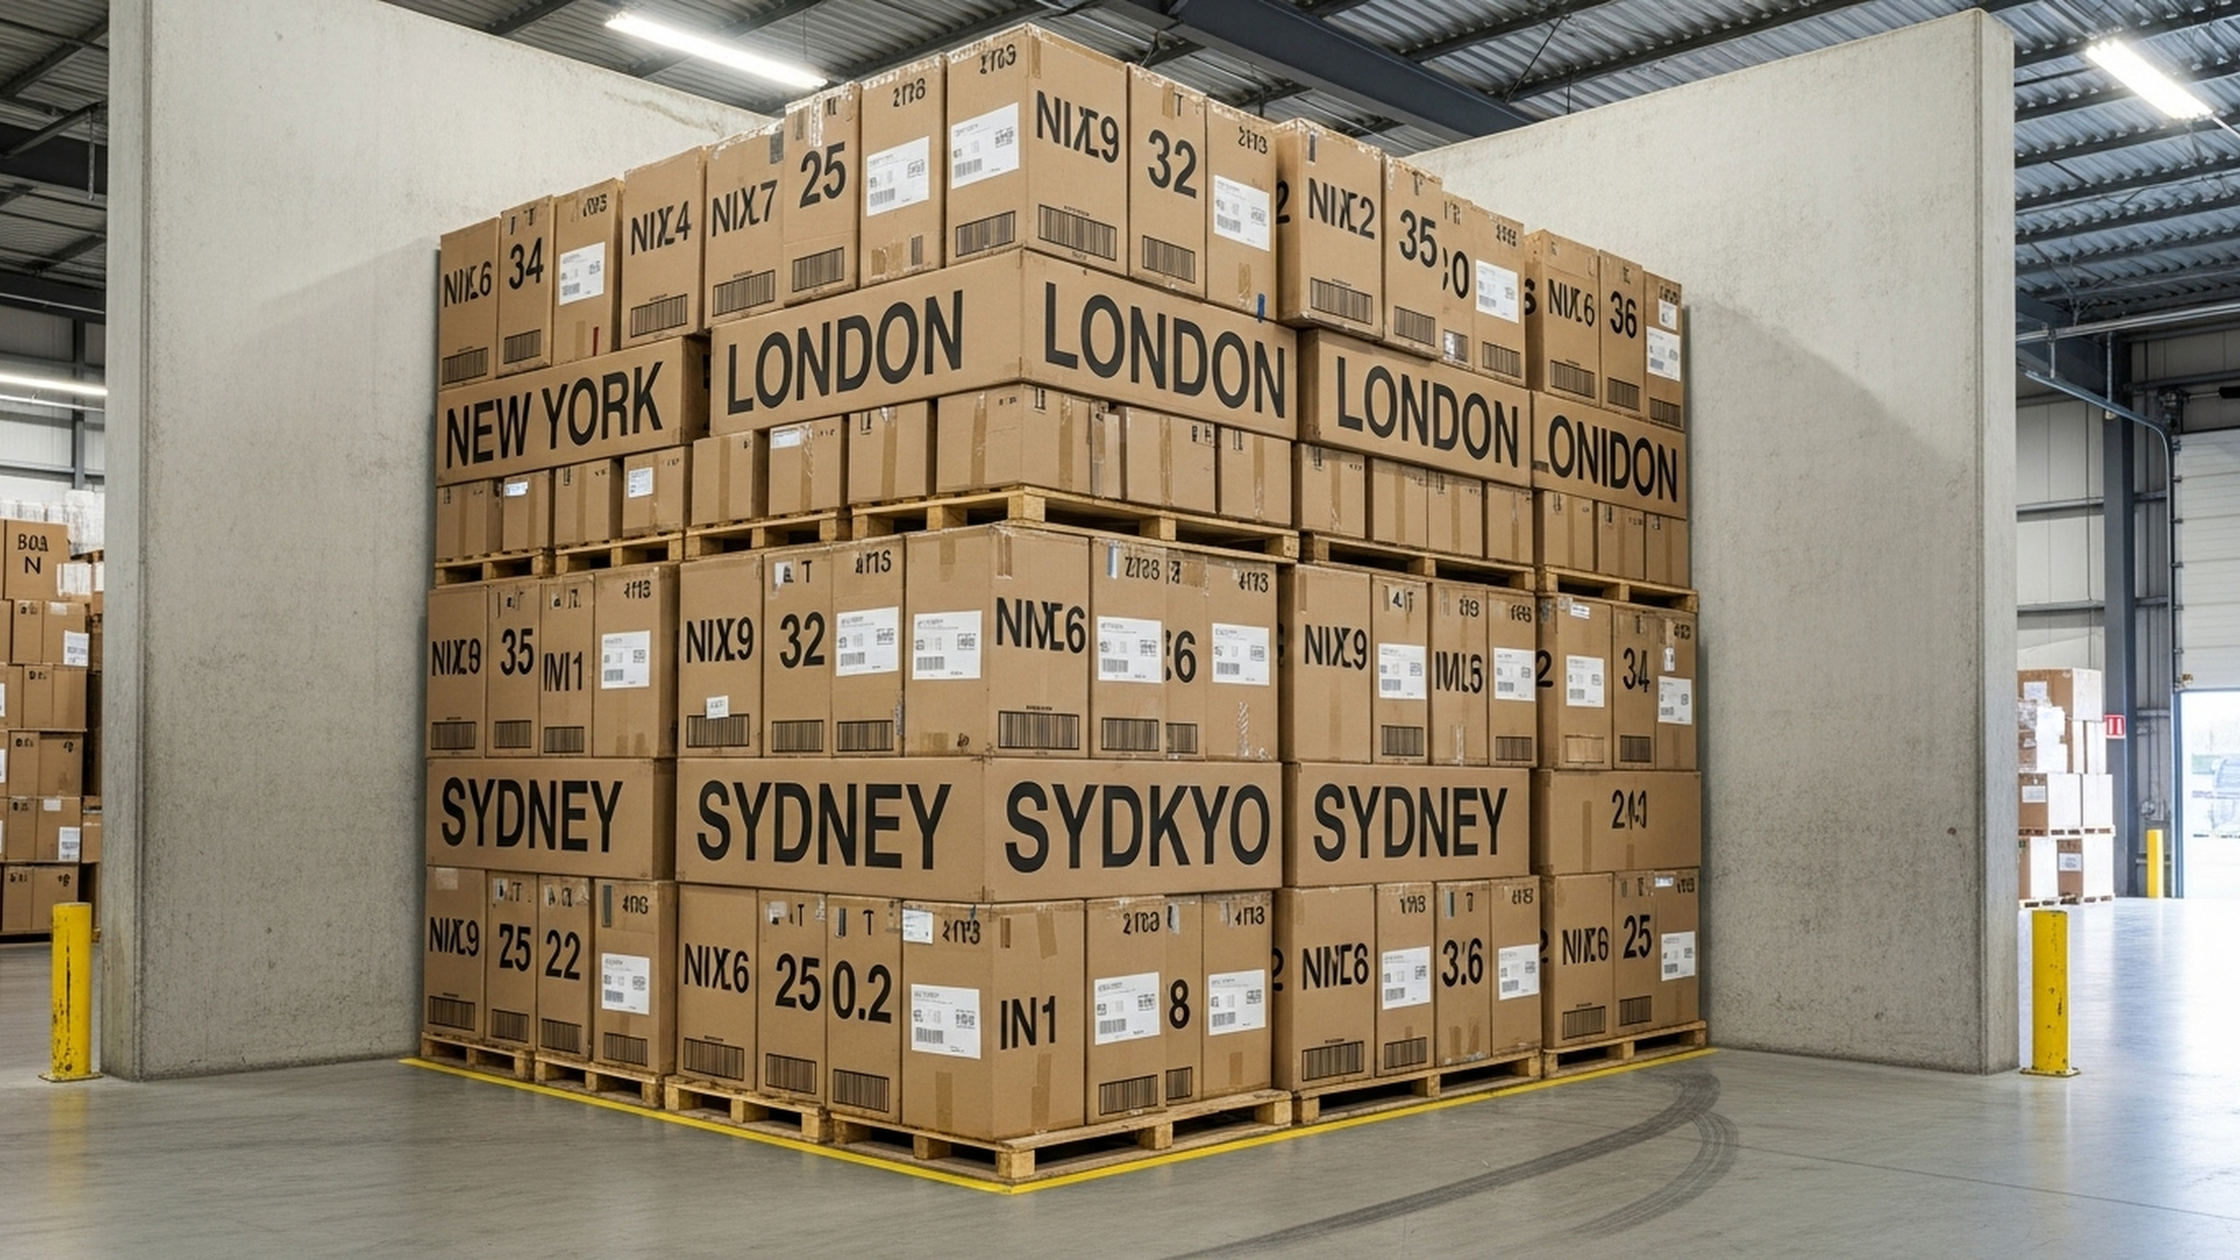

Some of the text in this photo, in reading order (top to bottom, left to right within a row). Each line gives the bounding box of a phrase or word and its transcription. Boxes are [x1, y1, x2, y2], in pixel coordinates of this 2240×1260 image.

[800, 142, 845, 208] 25
[1148, 130, 1196, 198] 32
[509, 238, 543, 289] 34
[1400, 210, 1437, 268] 35
[1610, 291, 1637, 338] 36
[727, 290, 963, 415] LONDON
[1045, 282, 1285, 418] LONDON
[447, 361, 663, 469] NEW YORK
[1337, 356, 1518, 468] LONDON
[1534, 415, 1677, 502] ONIDON
[25, 556, 40, 574] N
[501, 628, 533, 675] 35
[780, 612, 824, 668] 32
[442, 777, 623, 852] SYDNEY
[697, 780, 951, 870] SYDNEY
[1005, 781, 1270, 873] SYDKYO
[1314, 784, 1507, 862] SYDNEY
[500, 924, 531, 971] 25
[546, 930, 580, 980] 22
[1623, 915, 1652, 959] 25
[775, 953, 821, 1011] 25
[833, 961, 891, 1023] 0.2
[1169, 980, 1190, 1029] 8
